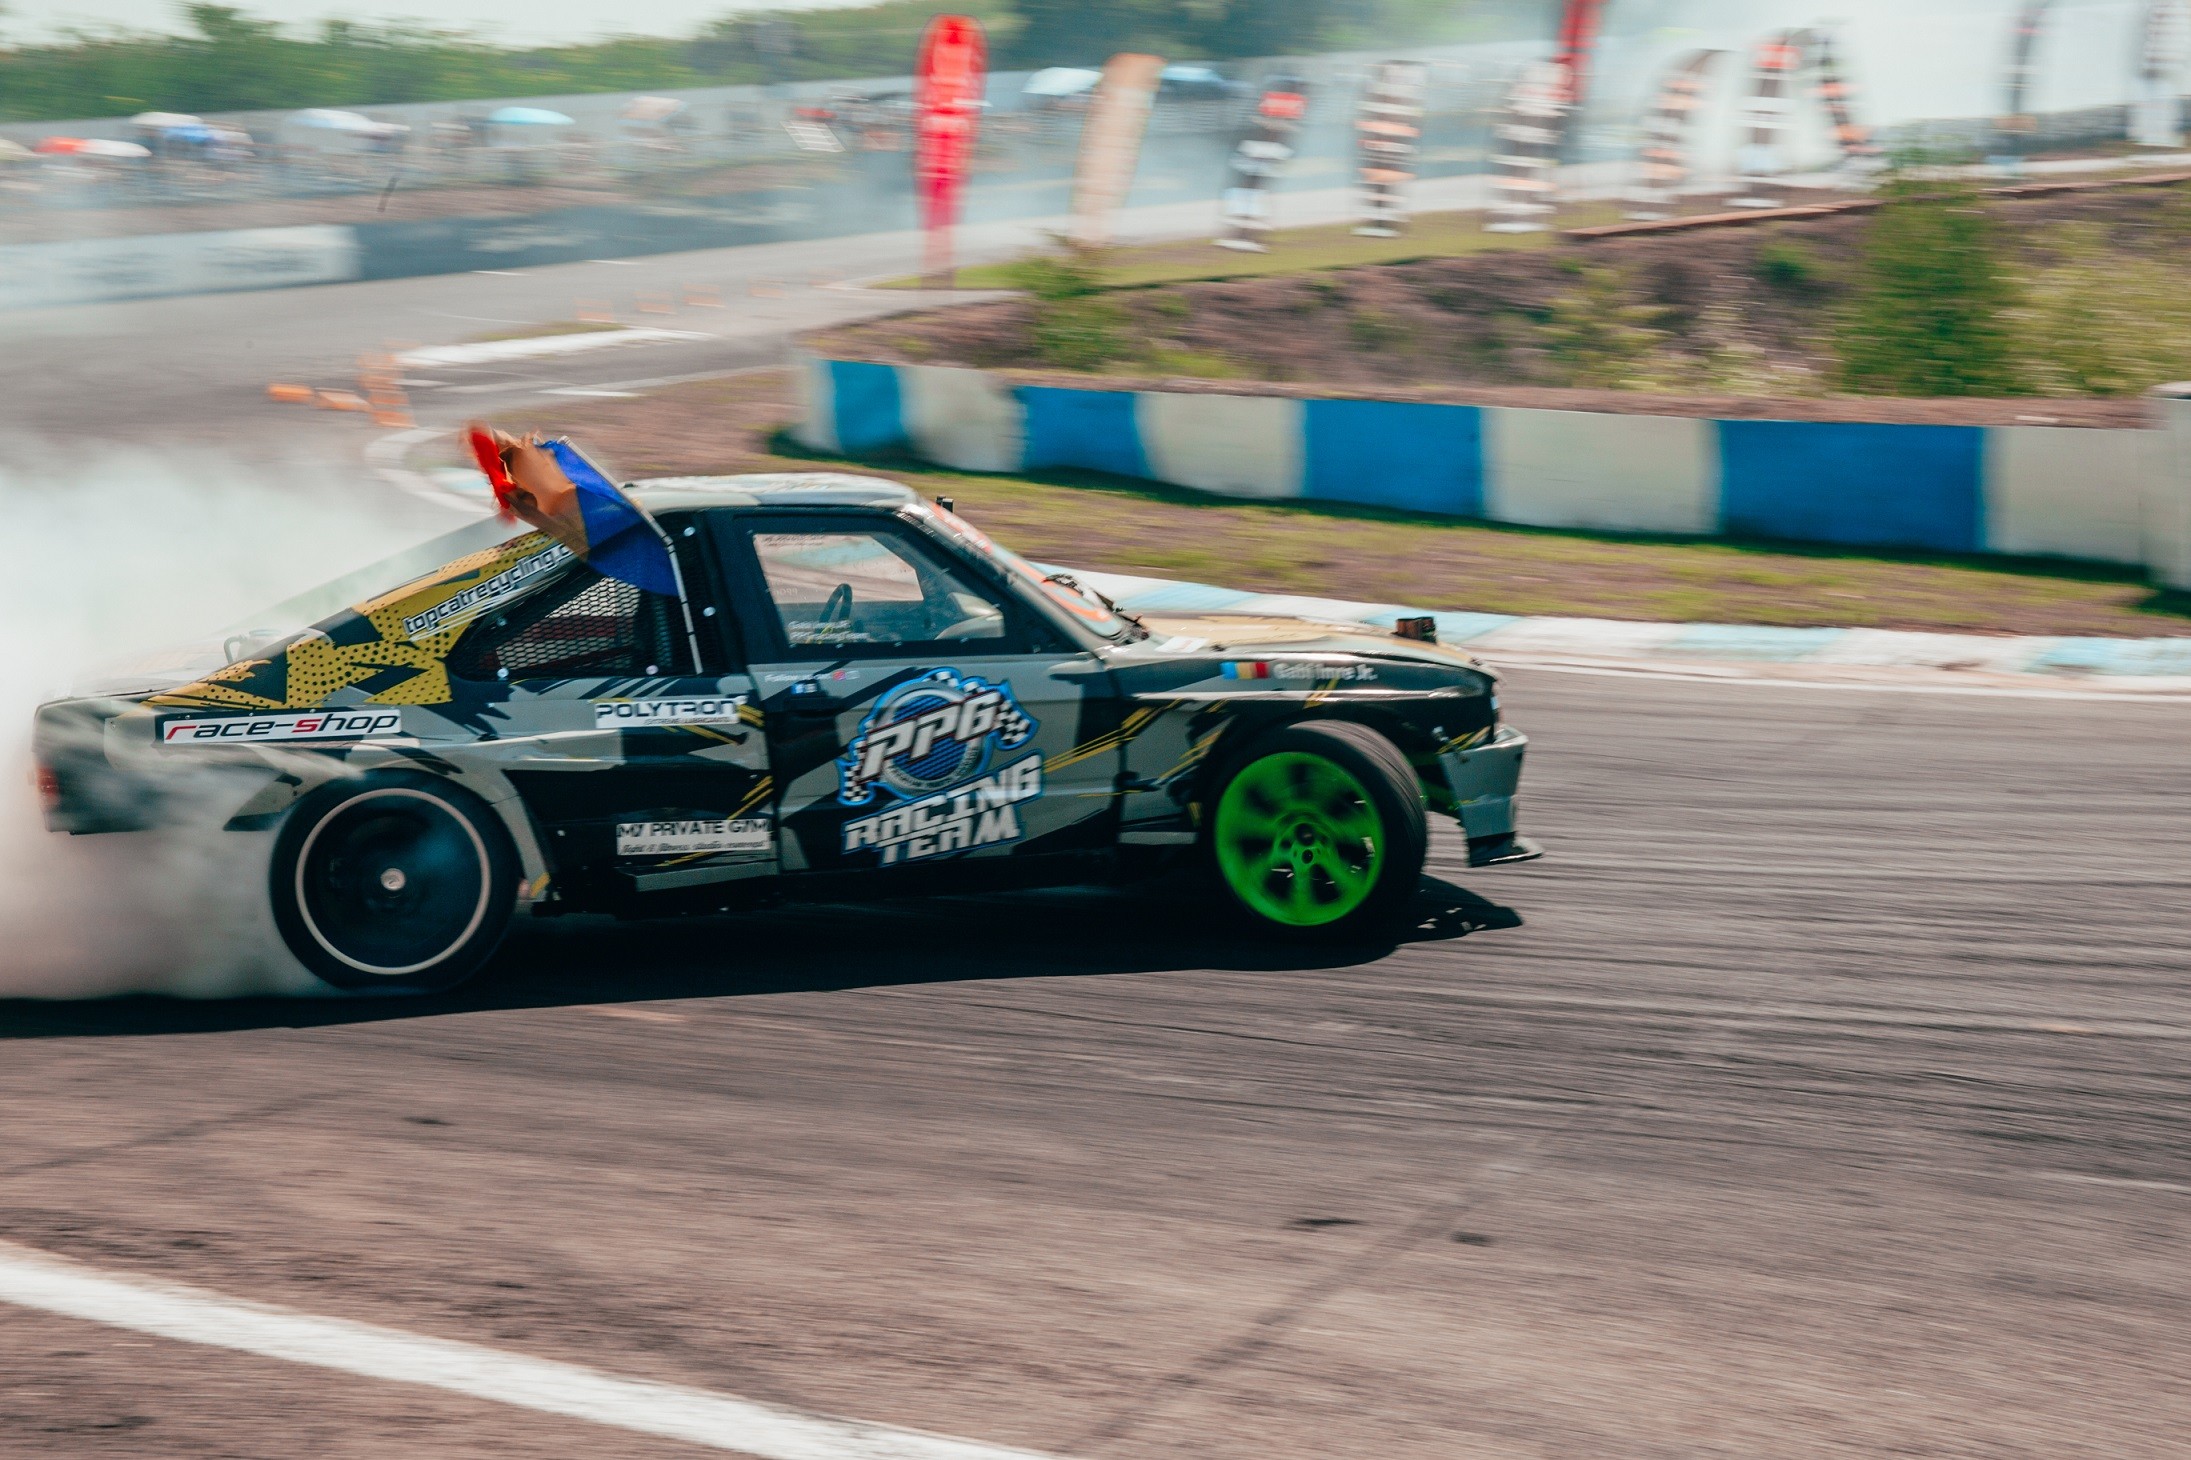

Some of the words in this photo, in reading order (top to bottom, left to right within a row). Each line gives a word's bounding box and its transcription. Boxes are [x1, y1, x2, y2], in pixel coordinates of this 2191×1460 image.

[165, 714, 399, 740] race-shop
[860, 691, 1000, 779] PPG
[650, 820, 725, 836] PRIVATE
[844, 753, 1042, 852] RACING
[876, 805, 1020, 863] TEAM
